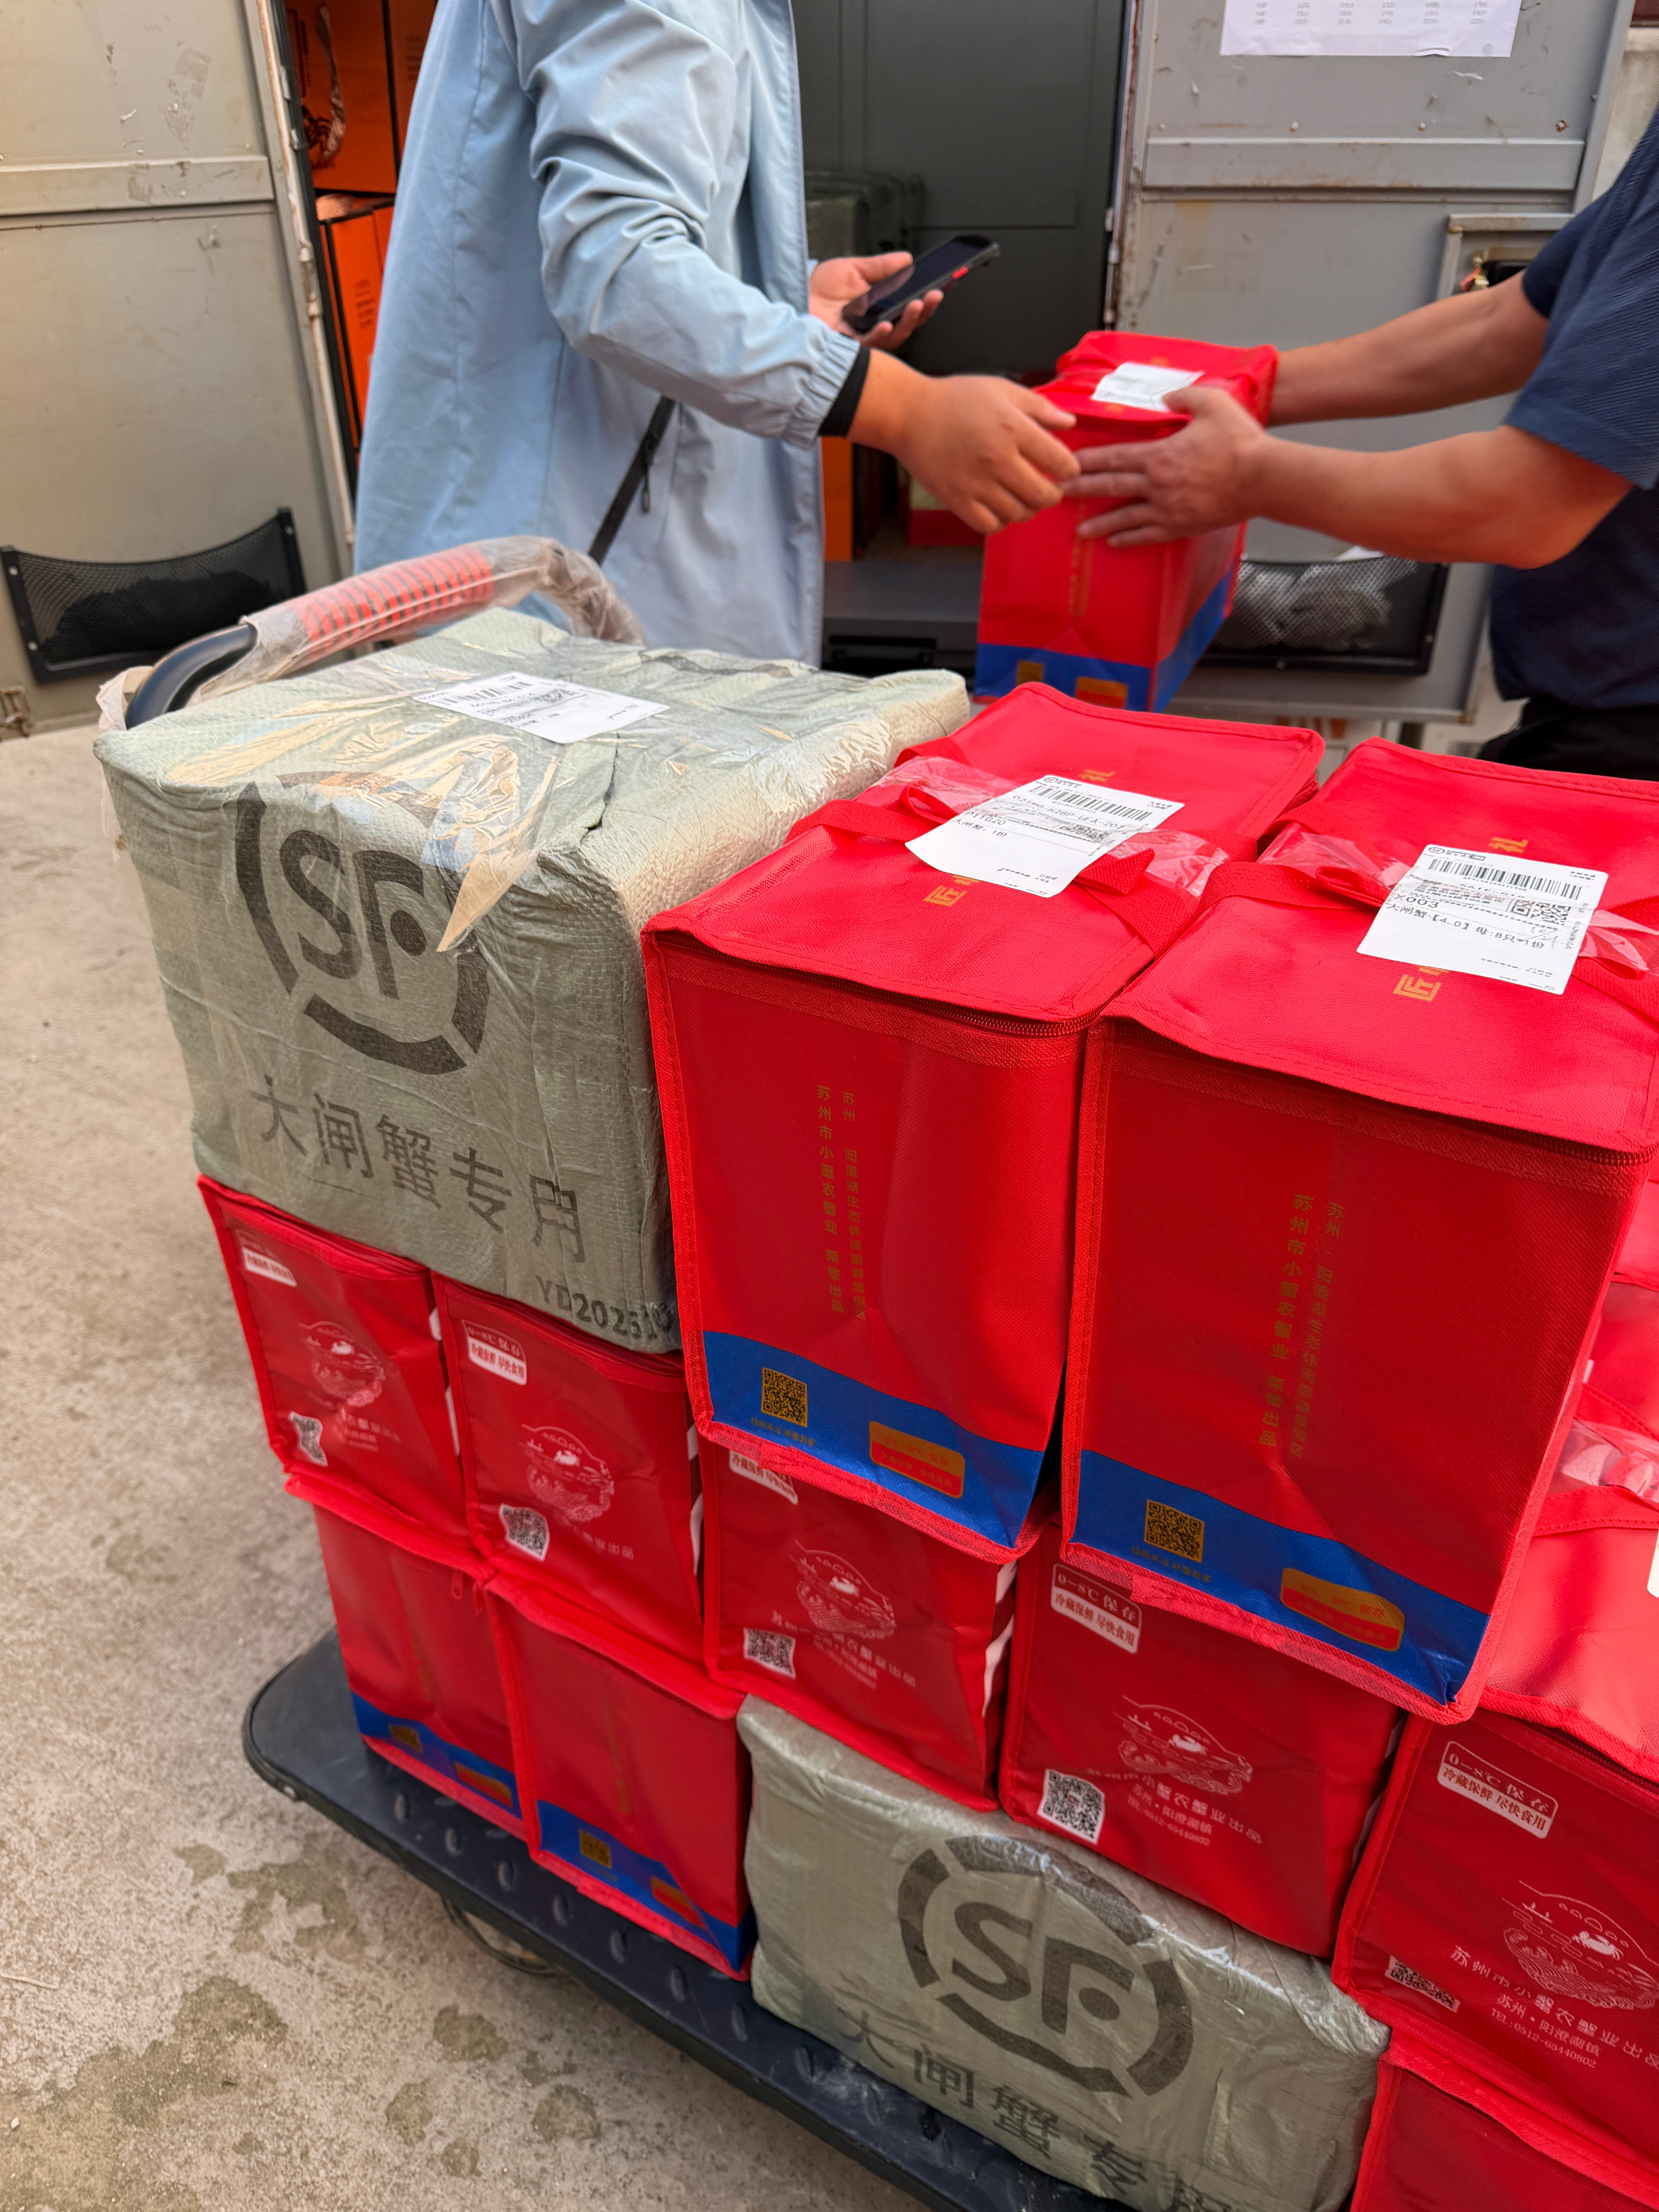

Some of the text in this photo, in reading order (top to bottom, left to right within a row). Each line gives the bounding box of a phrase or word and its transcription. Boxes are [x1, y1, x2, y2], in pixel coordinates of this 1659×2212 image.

[280, 830, 426, 999] SF
[250, 1075, 585, 1263] 大闸蟹专用
[1443, 1767, 1546, 1831] 冷藏保鲜 尽快食用
[951, 1901, 1135, 2035] SF
